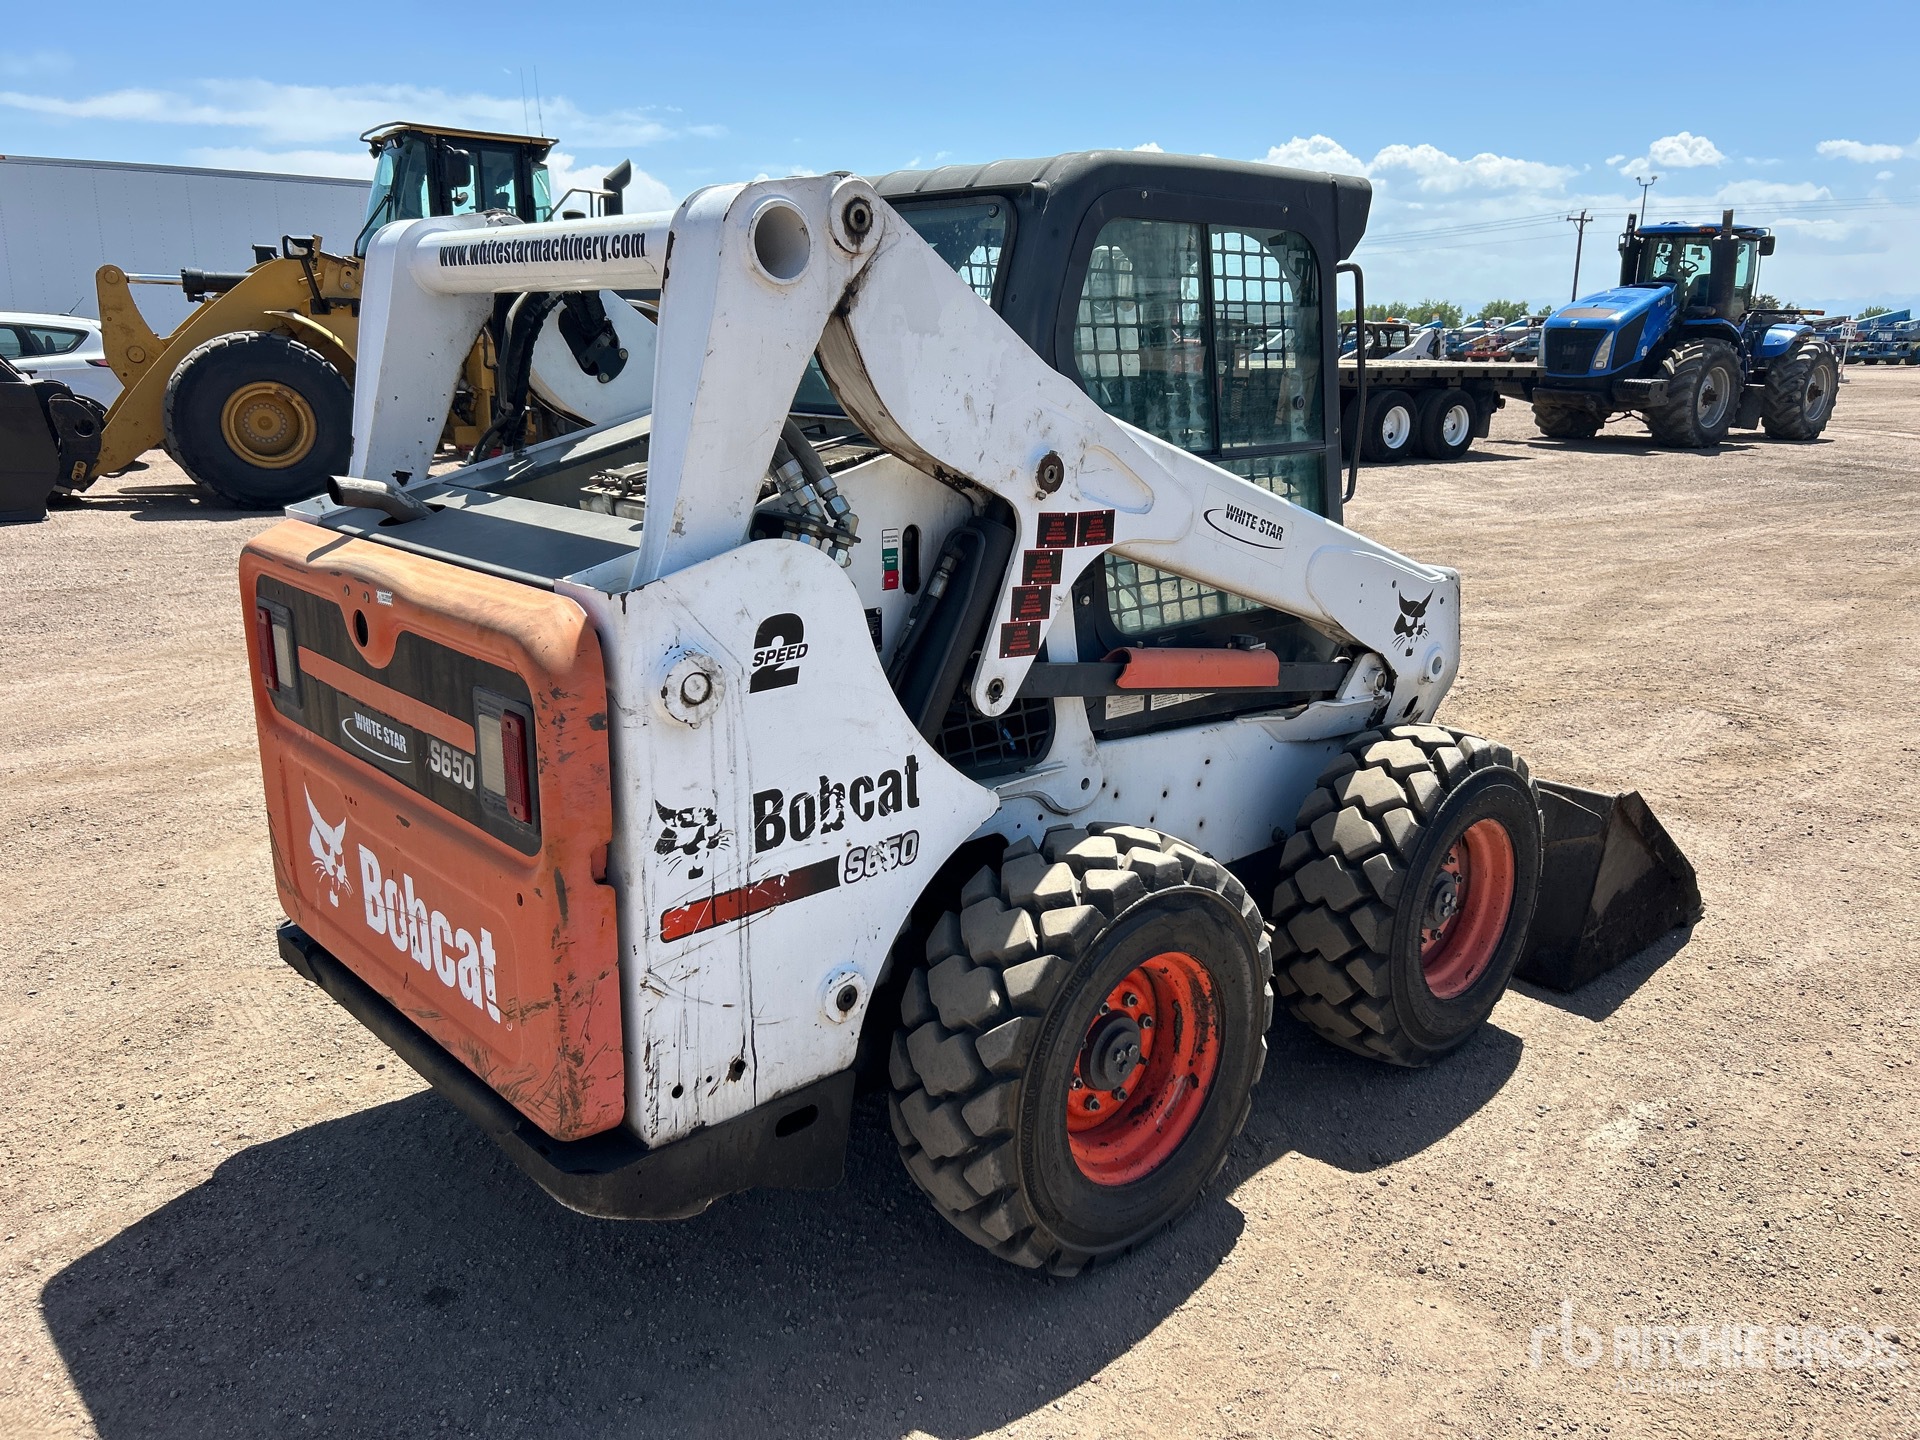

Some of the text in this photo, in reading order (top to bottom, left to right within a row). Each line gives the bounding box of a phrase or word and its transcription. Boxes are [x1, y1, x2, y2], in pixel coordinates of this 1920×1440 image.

[439, 232, 647, 267] www.whitestarmachinery.com
[1225, 503, 1284, 541] WHITE STAR
[749, 612, 804, 694] 2
[752, 643, 809, 668] SPEED
[354, 711, 407, 754] WHITE STAR
[430, 739, 475, 790] S650
[752, 754, 921, 854] Bobcat
[844, 829, 920, 885] S650
[358, 843, 501, 1024] Bobcat
